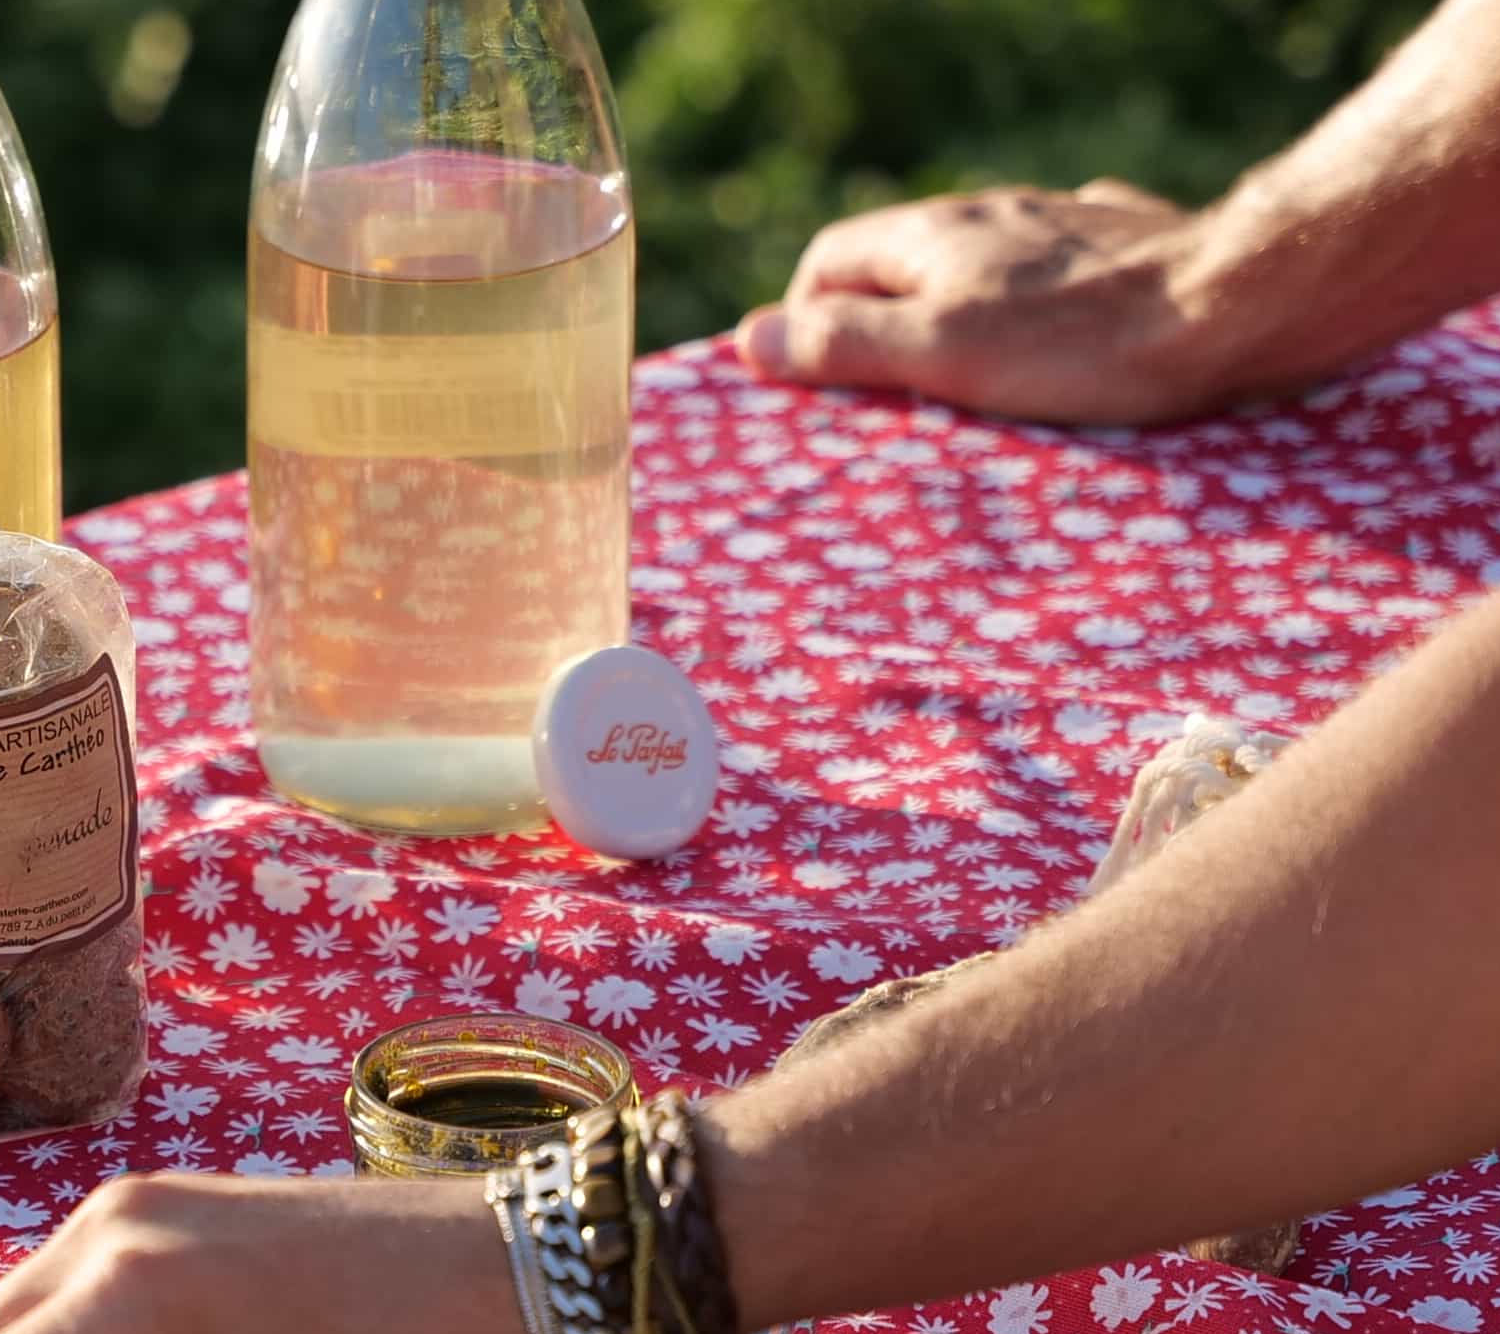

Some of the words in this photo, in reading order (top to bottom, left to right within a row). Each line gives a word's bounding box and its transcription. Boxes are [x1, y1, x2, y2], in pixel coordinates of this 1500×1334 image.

[20, 726, 105, 776] Carthéo
[586, 723, 624, 764] Le
[621, 723, 688, 776] Parfait
[46, 914, 58, 927] du
